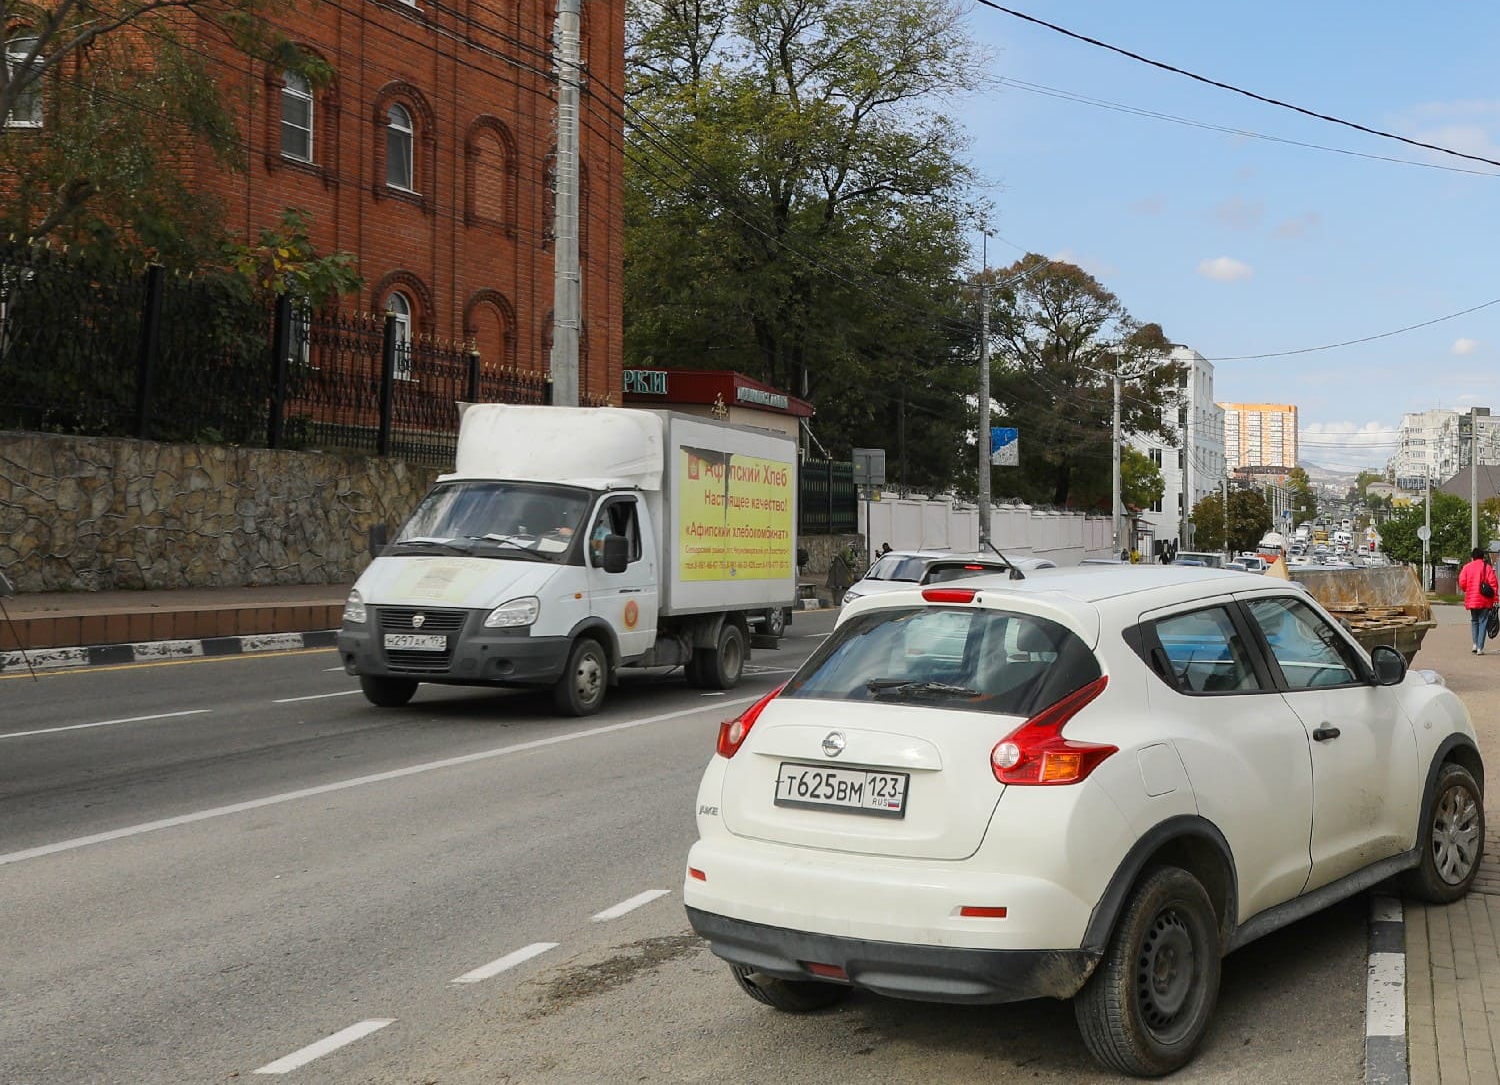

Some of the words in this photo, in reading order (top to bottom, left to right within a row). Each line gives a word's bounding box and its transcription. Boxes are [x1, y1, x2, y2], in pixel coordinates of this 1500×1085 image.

[705, 463, 760, 483] Афпский
[763, 465, 787, 487] Хлеб
[704, 490, 749, 510] Настящее
[752, 497, 788, 512] качество!
[868, 776, 898, 798] 123
[872, 798, 888, 807] RUS
